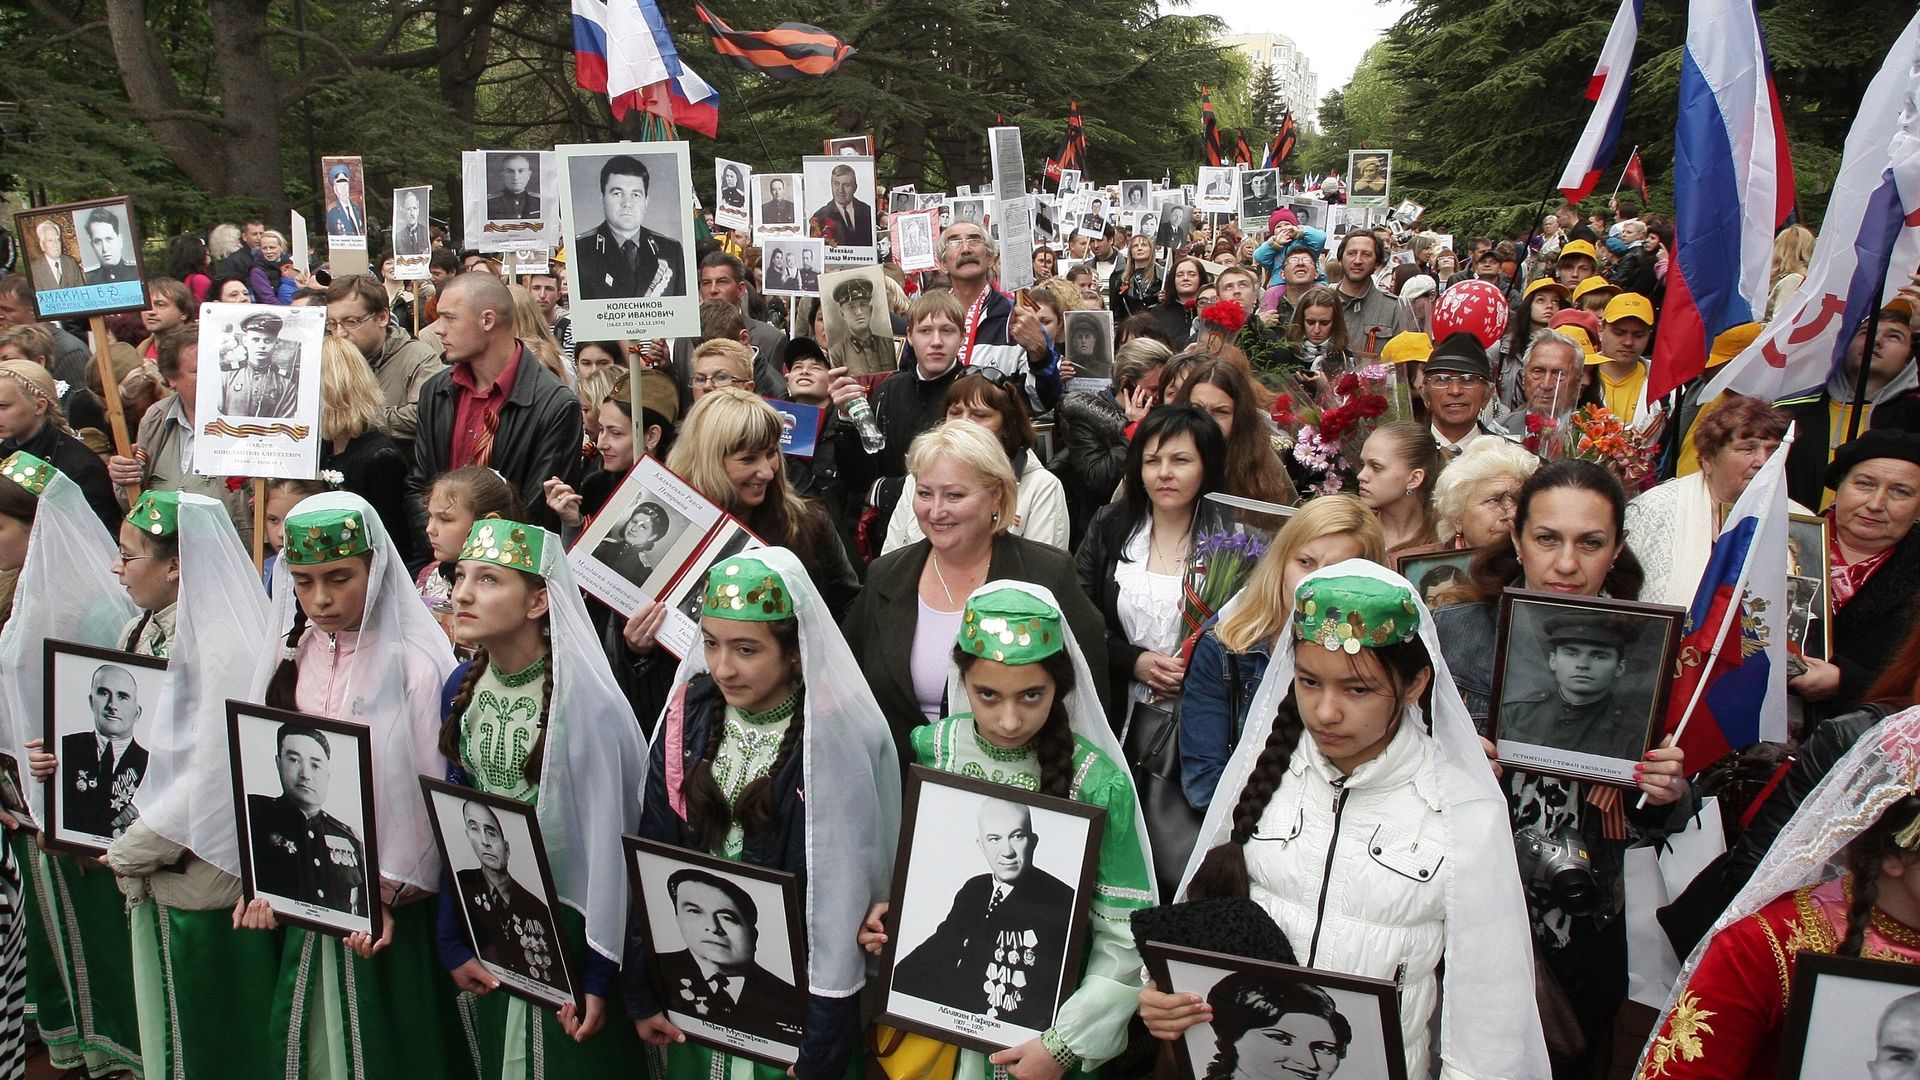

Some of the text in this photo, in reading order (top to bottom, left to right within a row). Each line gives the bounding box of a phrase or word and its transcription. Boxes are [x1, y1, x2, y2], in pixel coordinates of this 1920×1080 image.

[606, 301, 663, 310] КОЛЕСНИКОВ
[596, 310, 674, 321] ФЁДОР ИВАНОВИЧ
[658, 486, 689, 511] Петровна
[685, 495, 704, 511] Раиса
[1512, 753, 1621, 775] УСТИМЕНКО СТЕФАН ЯКОВЛЕВИЧ
